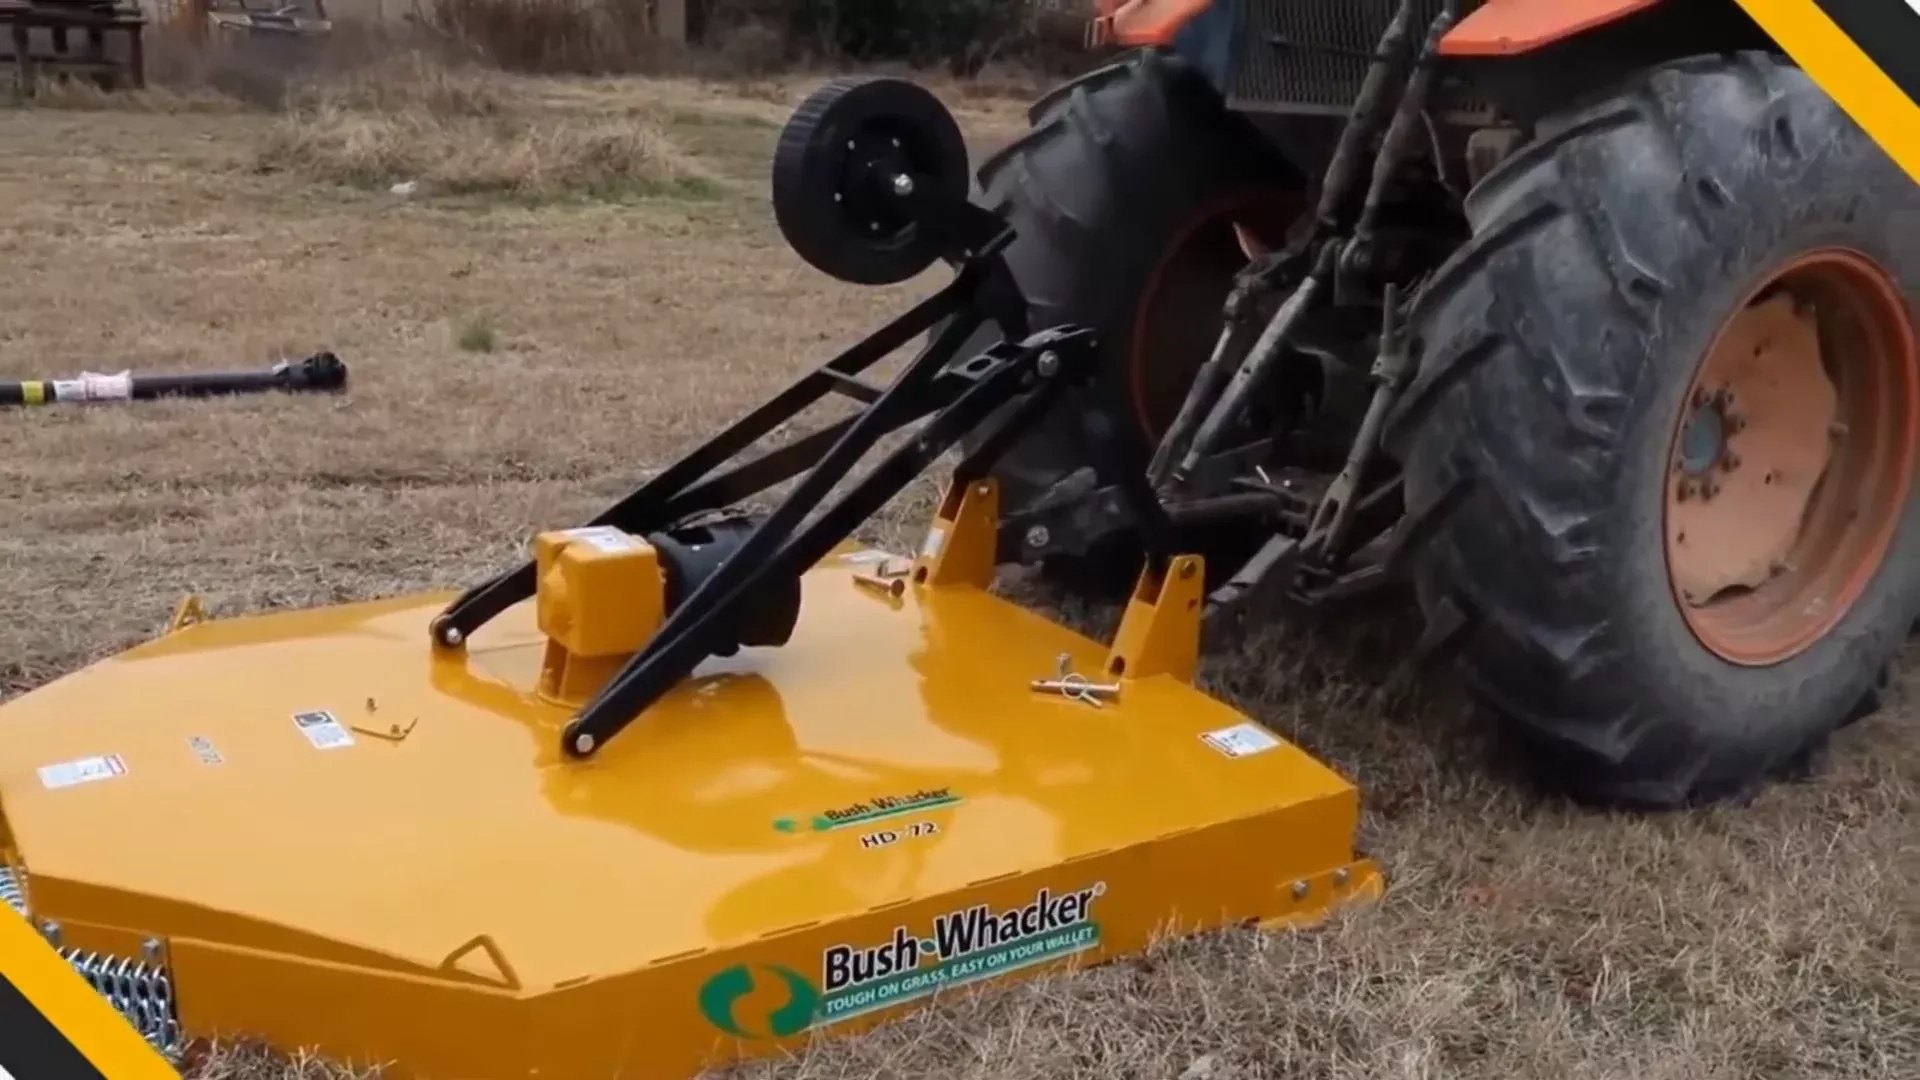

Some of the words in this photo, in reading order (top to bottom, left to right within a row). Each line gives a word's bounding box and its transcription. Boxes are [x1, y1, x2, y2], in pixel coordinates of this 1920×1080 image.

[826, 988, 876, 1013] TOUGH
[878, 981, 899, 998] ON
[951, 957, 986, 978] EASY
[986, 950, 1008, 967] ON
[1009, 939, 1044, 960] YOUR
[1045, 926, 1093, 950] WALLET
